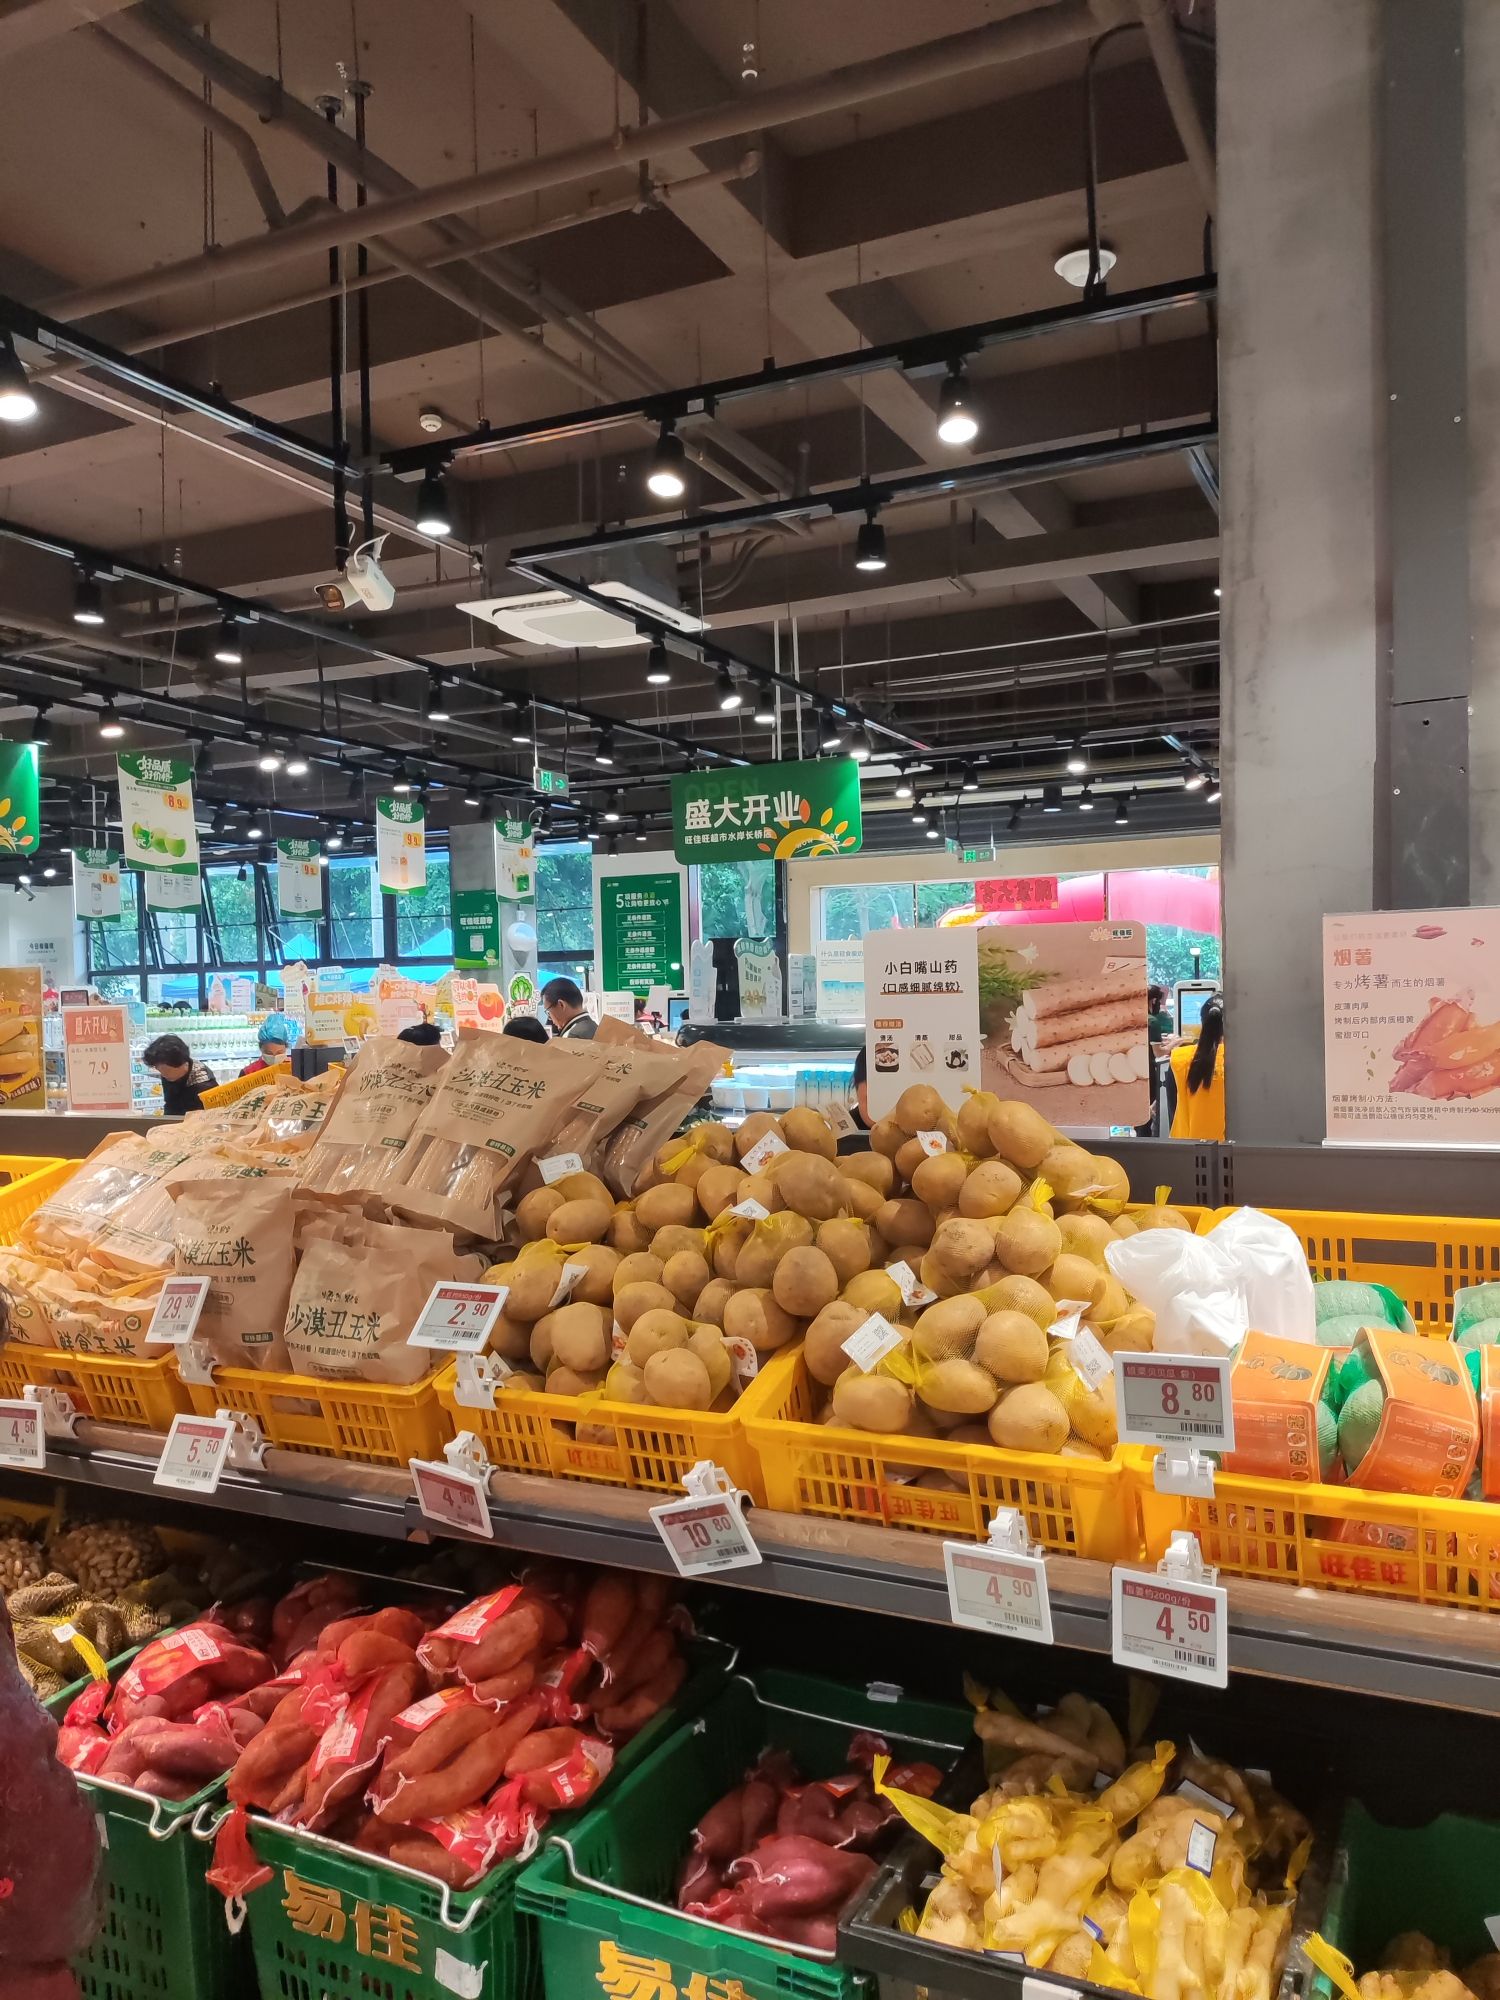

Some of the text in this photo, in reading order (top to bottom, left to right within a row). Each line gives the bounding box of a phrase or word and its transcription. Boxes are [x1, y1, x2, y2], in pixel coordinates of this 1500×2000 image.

[137, 755, 171, 772] 好品质
[685, 790, 802, 829] 盛大开业
[616, 894, 625, 908] 5
[1333, 949, 1372, 967] 烟薯
[885, 959, 958, 976] 小白嘴山药
[1333, 974, 1446, 991] 专为烤薯而生的烟薯
[1334, 1002, 1369, 1011] 皮薄肉厚
[75, 1015, 109, 1036] 盛大开业
[88, 1061, 110, 1076] 7.9
[452, 1068, 546, 1100] 沙漠丑玉米
[1318, 1551, 1409, 1585] 旺佳旺
[281, 1869, 423, 1975] 易佳
